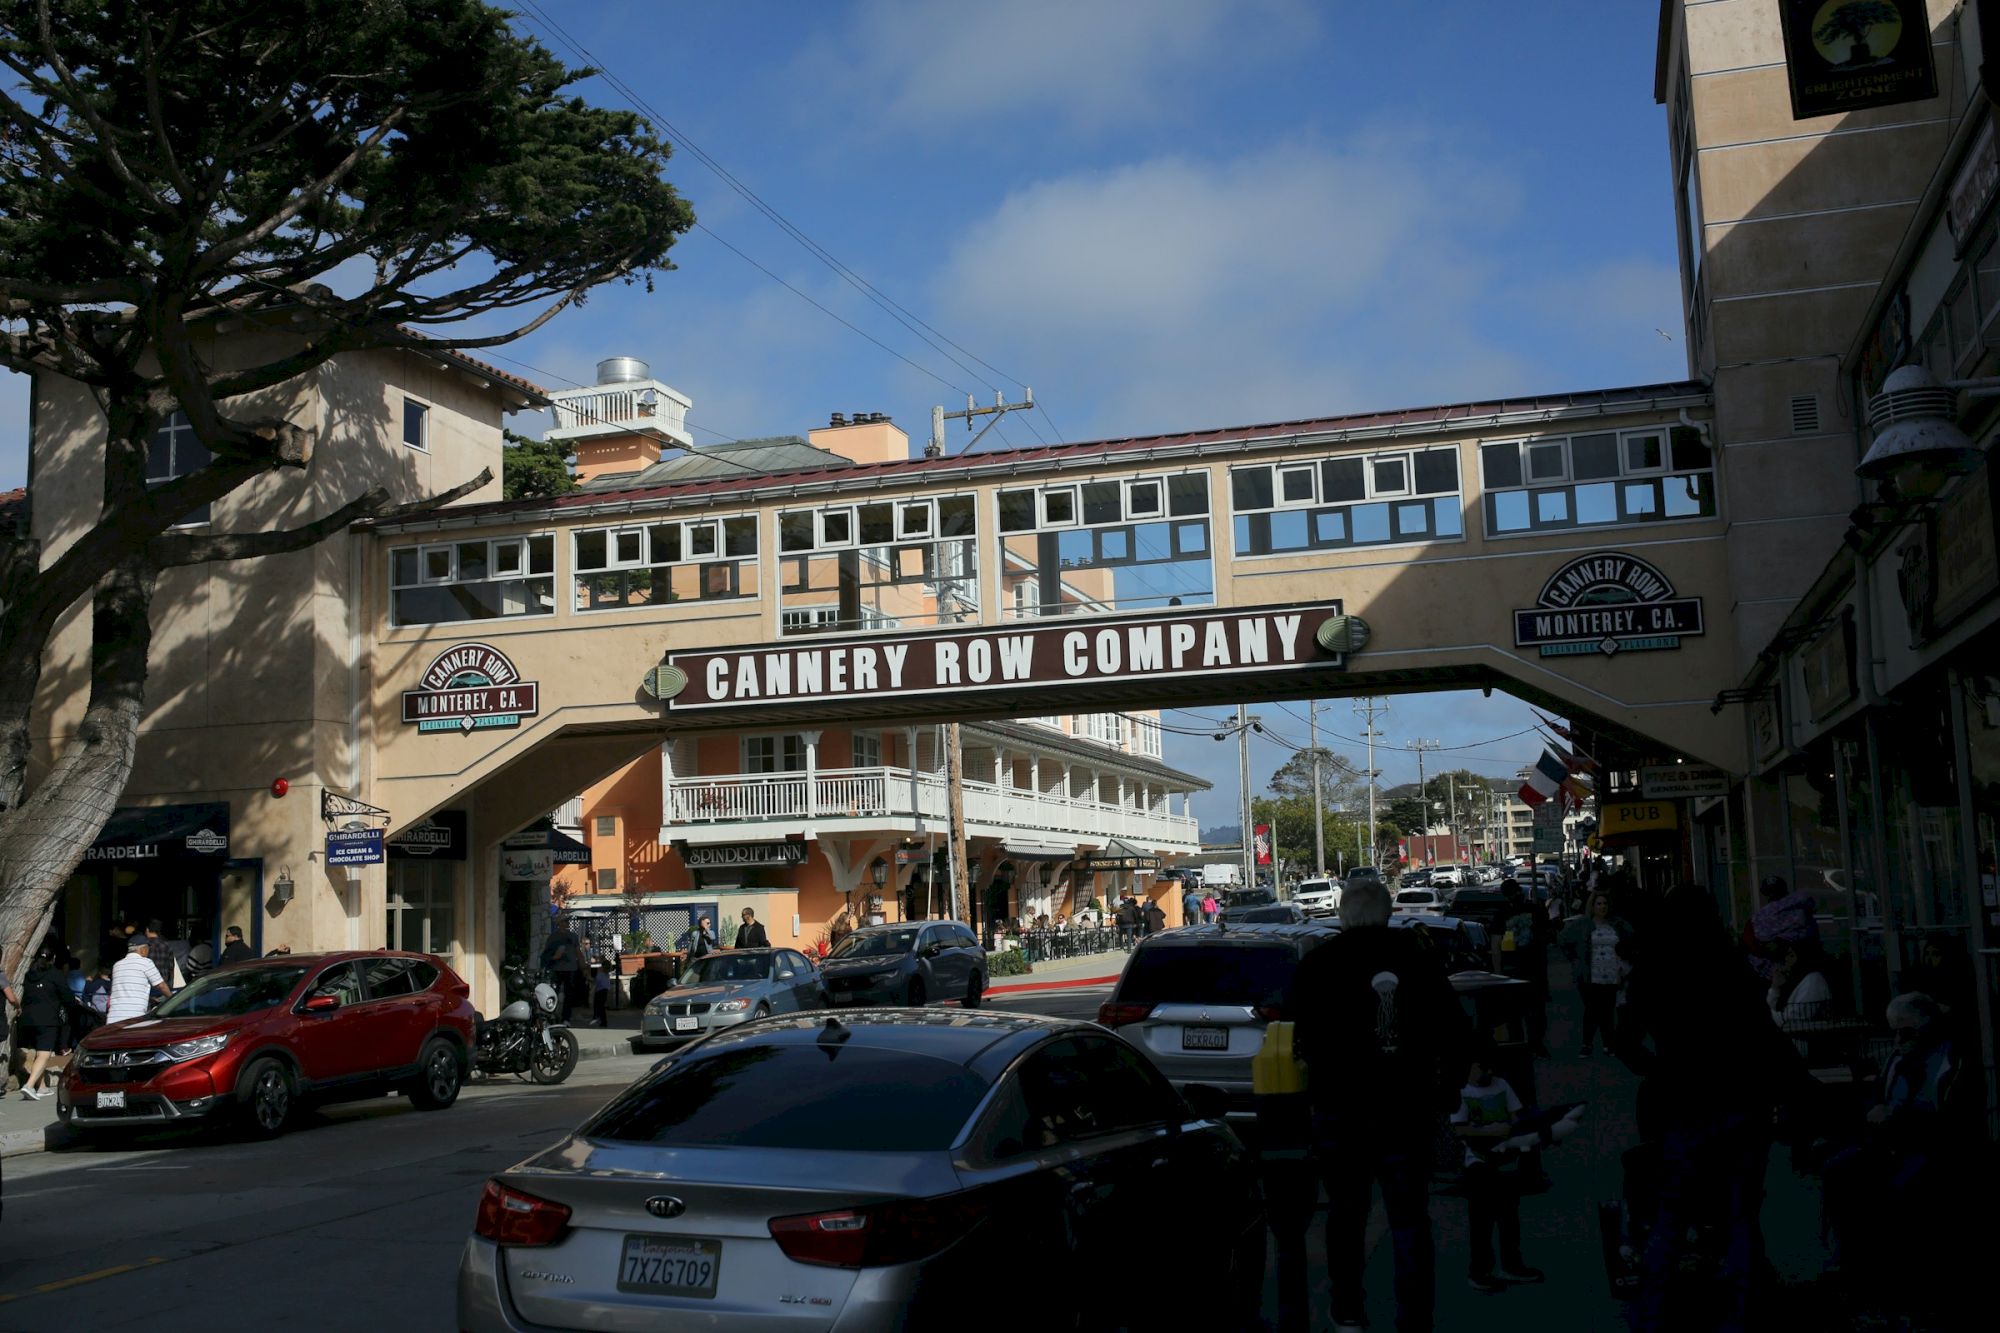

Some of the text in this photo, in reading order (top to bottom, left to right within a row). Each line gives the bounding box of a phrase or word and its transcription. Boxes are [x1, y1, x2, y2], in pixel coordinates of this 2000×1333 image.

[1805, 66, 1924, 95] ENLIGHTENMENT
[1835, 82, 1897, 101] ZONE
[1549, 558, 1664, 606] CANNERY ROW
[1535, 607, 1684, 637] MONTEREY, CA.
[428, 649, 511, 688] CANNERY ROW
[705, 614, 1302, 700] CANNERY ROW COMPANY
[417, 690, 522, 714] MONTEREY, CA.
[1620, 806, 1660, 822] PUB
[329, 831, 380, 841] GHIRARDELLI
[328, 855, 363, 863] CHOCOLATE
[553, 850, 589, 861] RARDELLI
[689, 845, 801, 865] SPINDRIFT INN
[628, 1257, 711, 1287] 7XZG709
